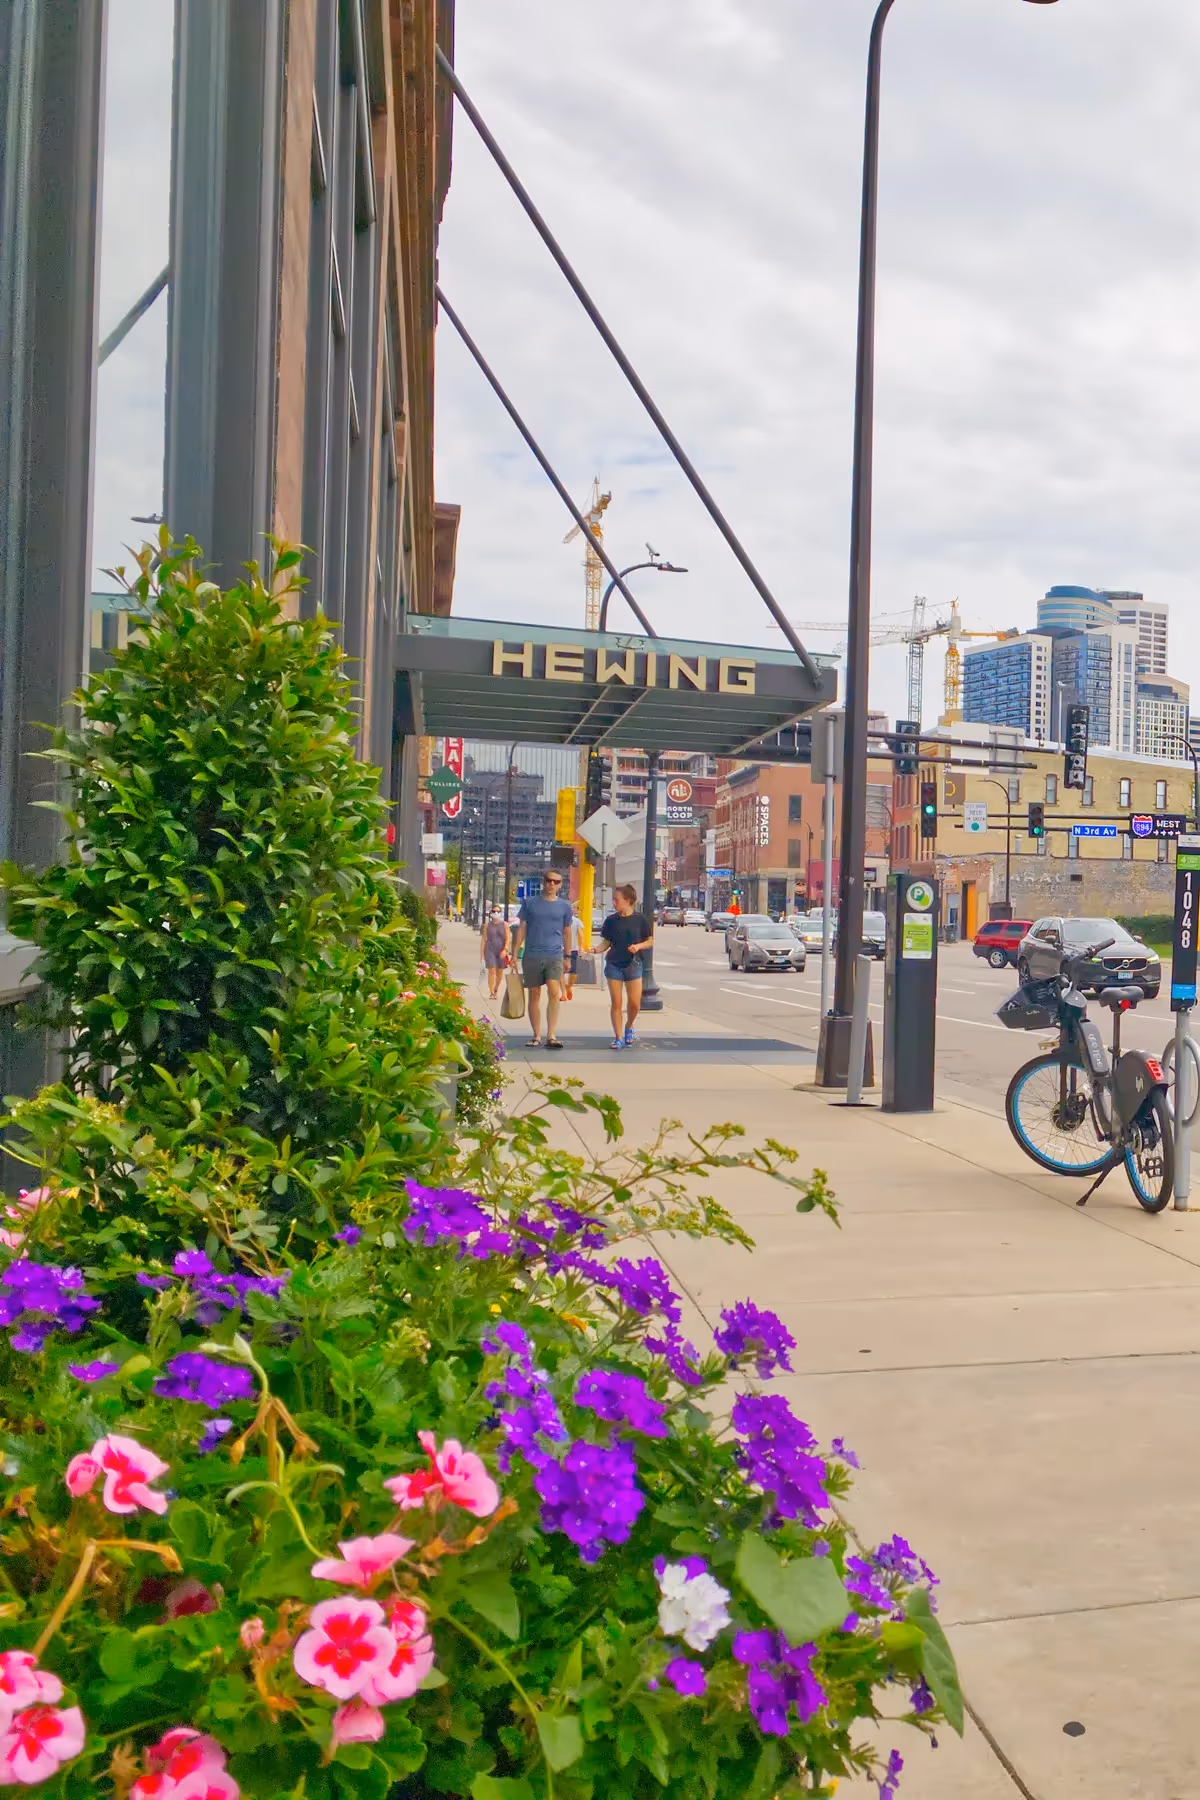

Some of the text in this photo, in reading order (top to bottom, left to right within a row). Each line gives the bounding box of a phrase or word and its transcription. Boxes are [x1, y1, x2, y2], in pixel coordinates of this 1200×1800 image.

[493, 639, 756, 694] HEWING
[1074, 827, 1115, 836] N 3rd Av
[1156, 820, 1180, 828] WEST
[1181, 872, 1193, 949] 1048
